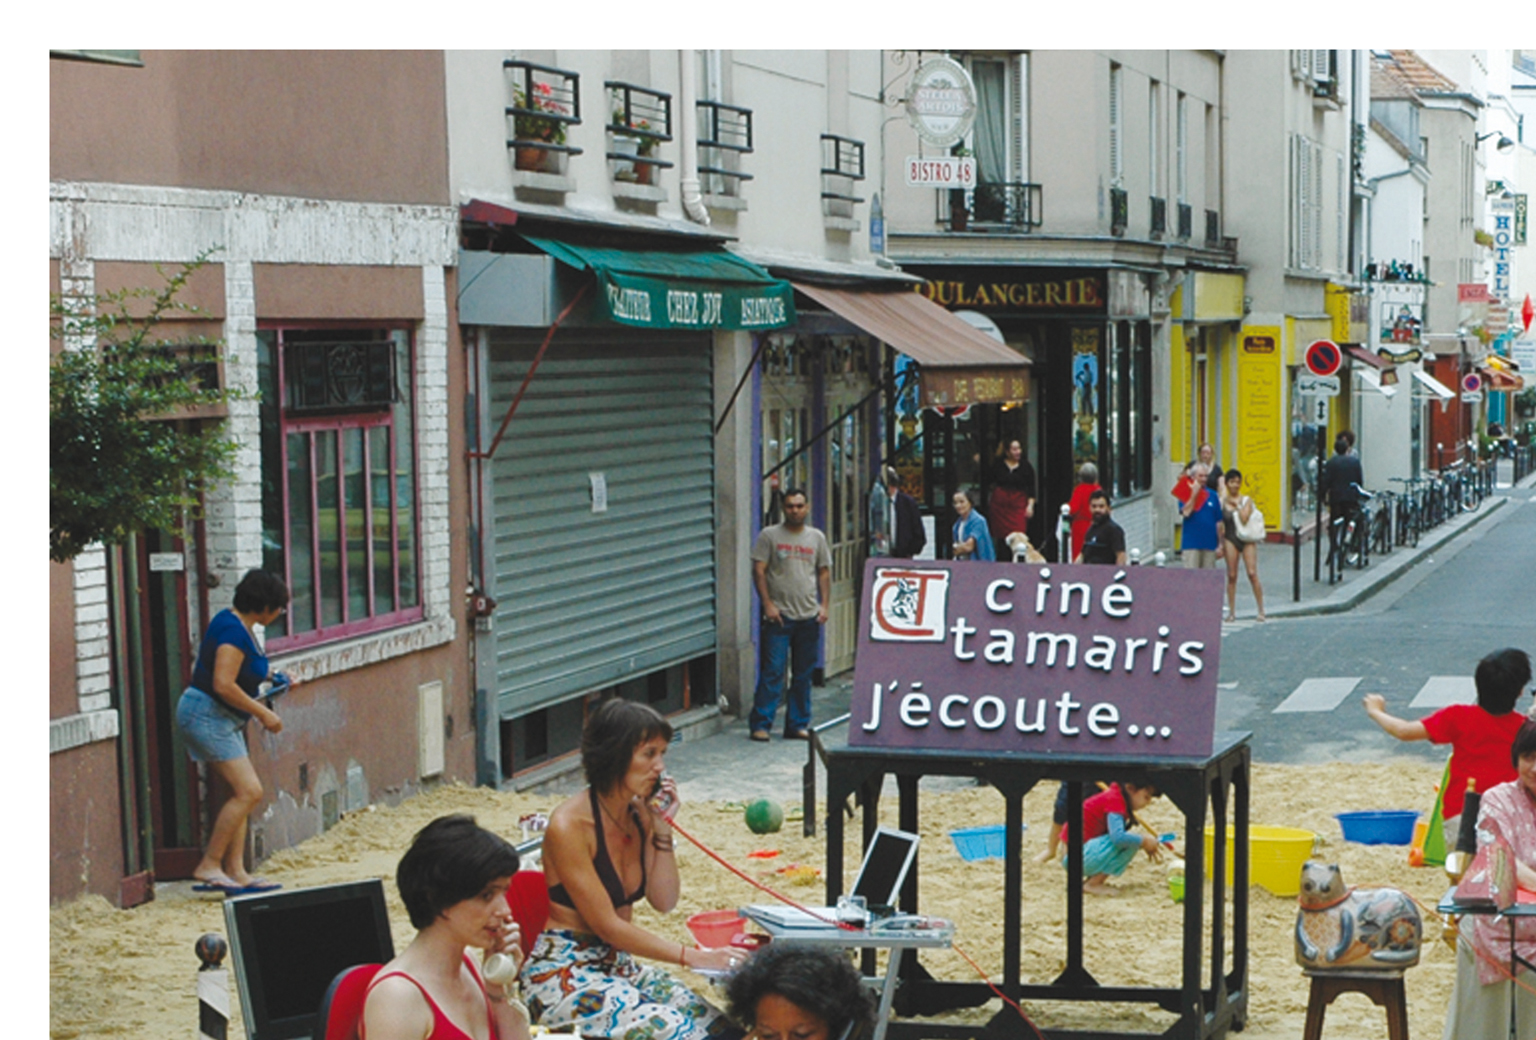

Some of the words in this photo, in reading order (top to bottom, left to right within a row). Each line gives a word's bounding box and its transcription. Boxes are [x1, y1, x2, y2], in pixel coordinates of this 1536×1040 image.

[911, 162, 951, 182] BISTRO
[957, 163, 972, 182] 48
[1515, 195, 1526, 242] HOTEL
[1495, 216, 1510, 291] HOTEL
[667, 290, 698, 325] CHEZ
[914, 277, 1097, 305] OULANGERIE
[985, 567, 1134, 618] ciné
[950, 616, 1206, 677] tamaris
